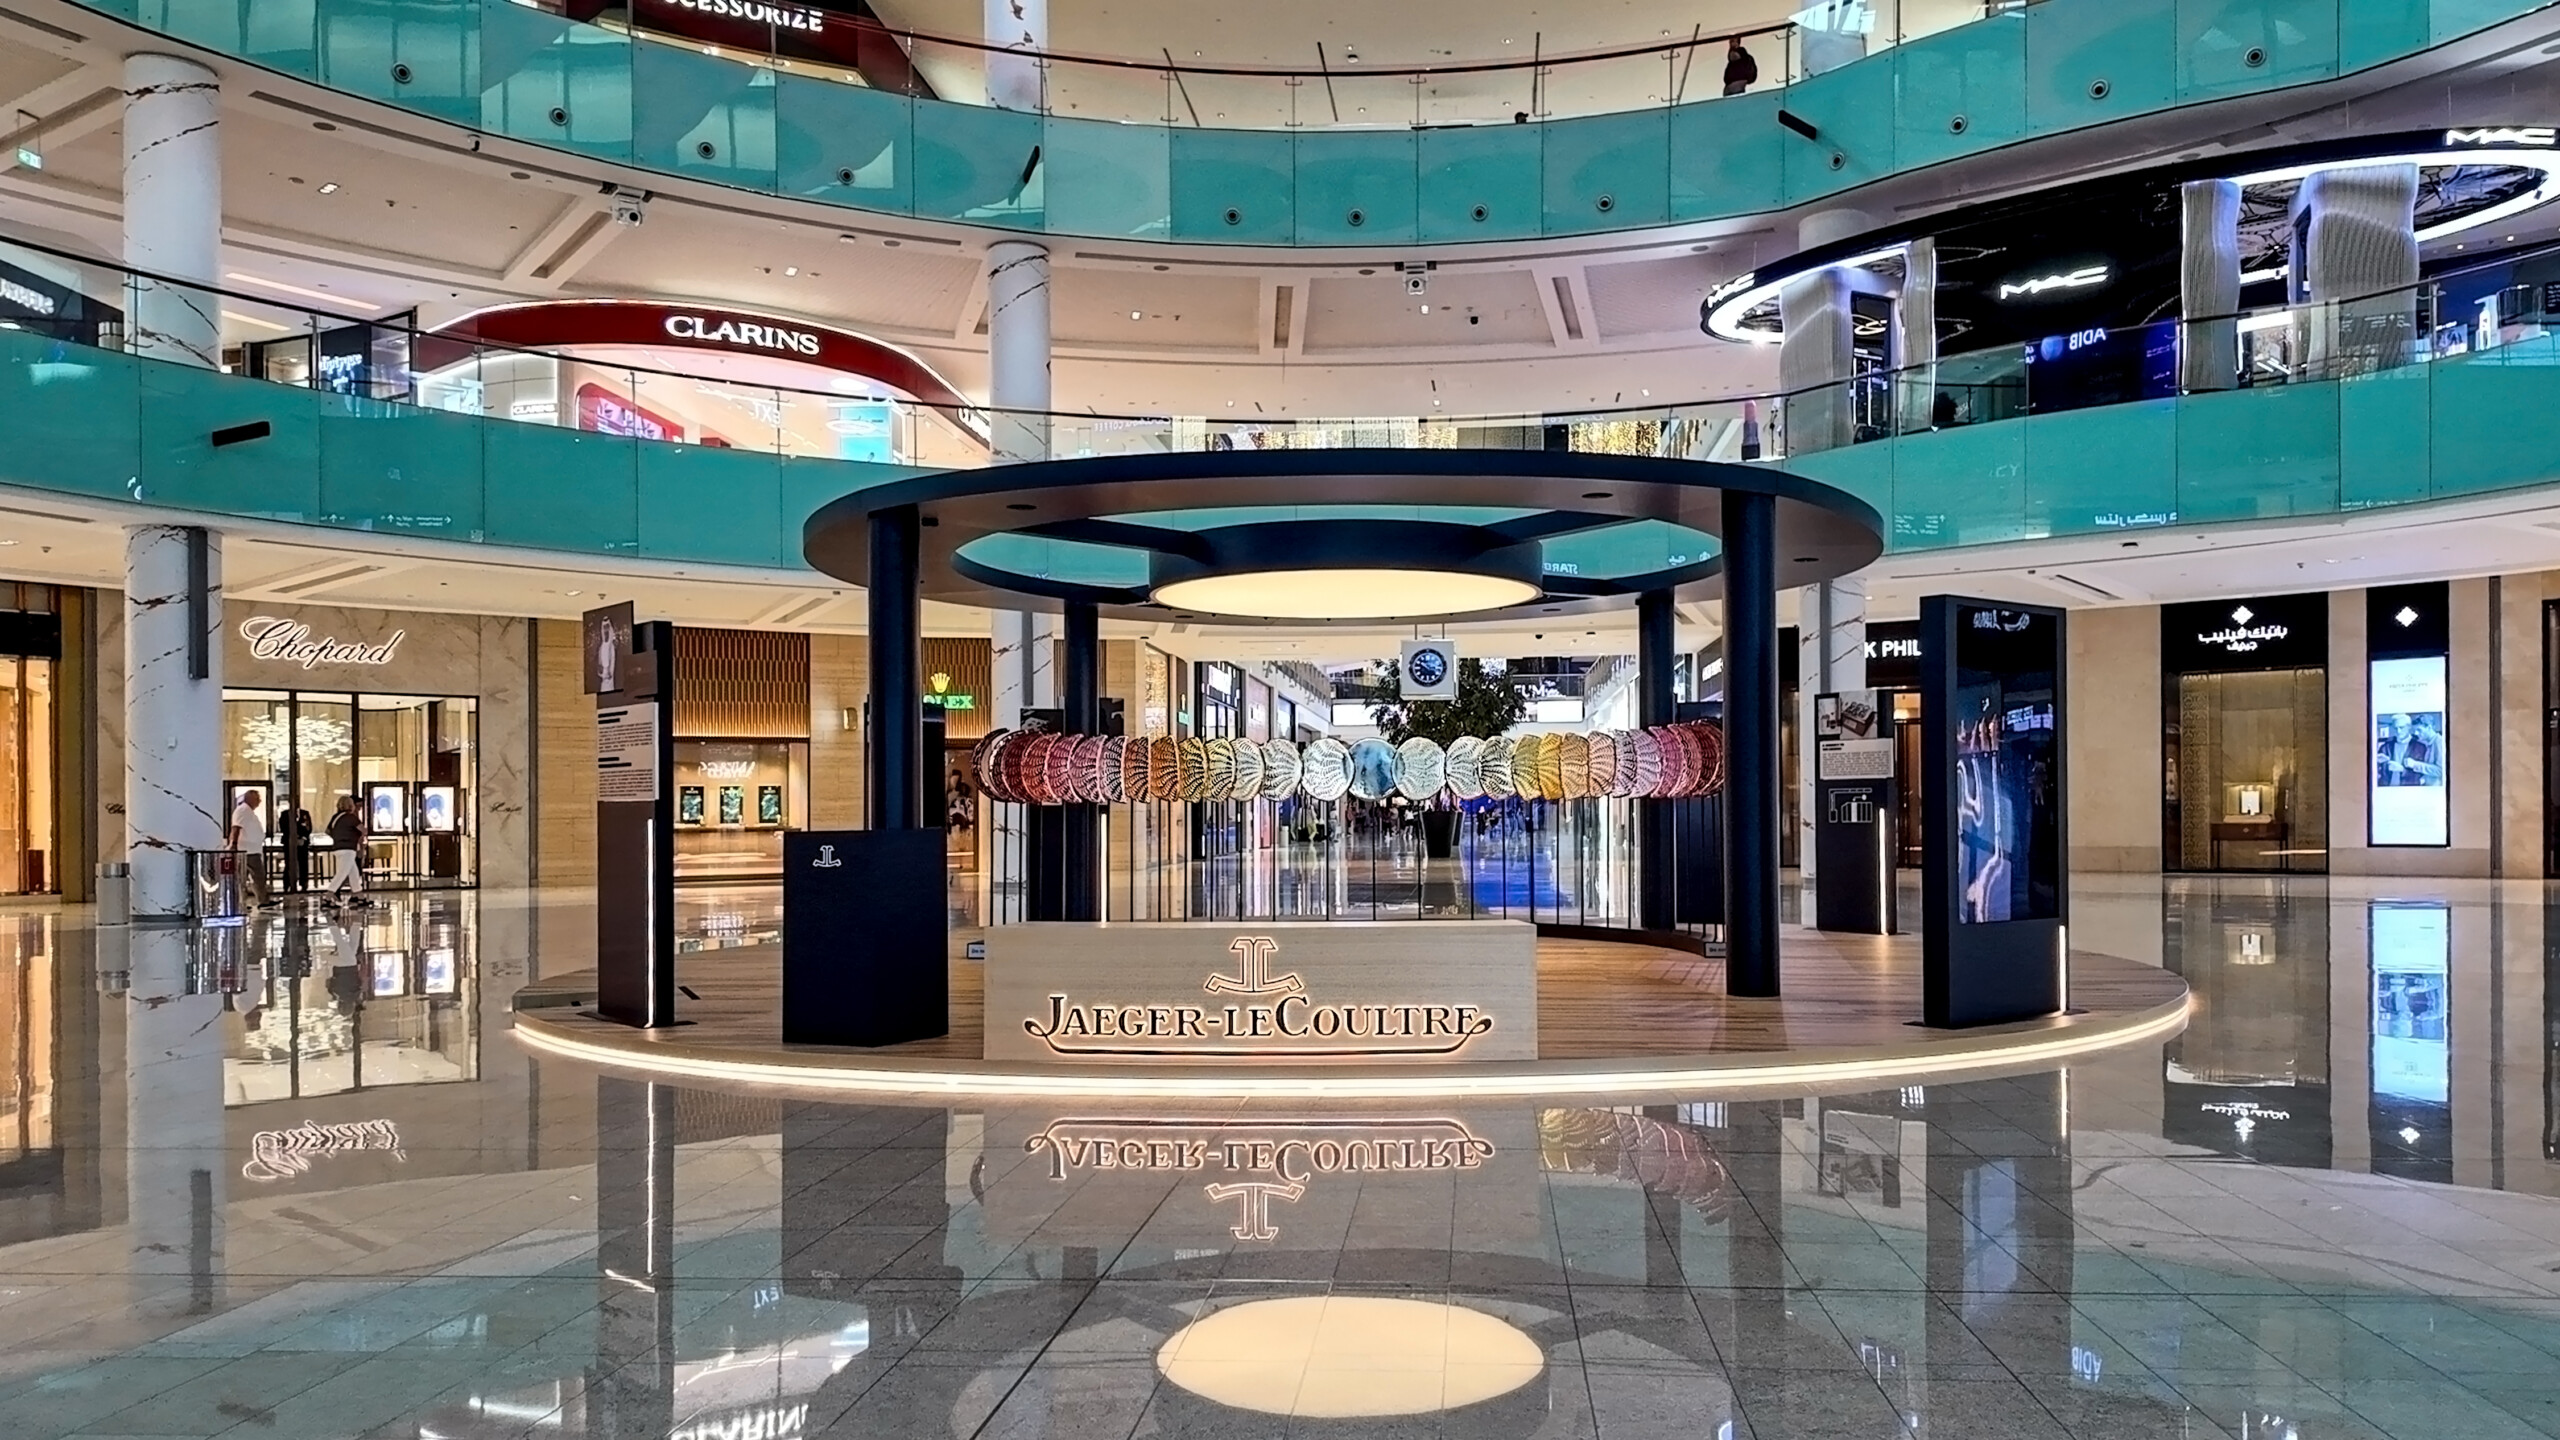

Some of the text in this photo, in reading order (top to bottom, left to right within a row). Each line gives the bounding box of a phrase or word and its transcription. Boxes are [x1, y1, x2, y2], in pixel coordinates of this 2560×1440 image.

[2446, 128, 2556, 146] MAC
[2000, 266, 2108, 300] MAC
[665, 315, 820, 356] CLARINS
[239, 615, 406, 669] Chopard
